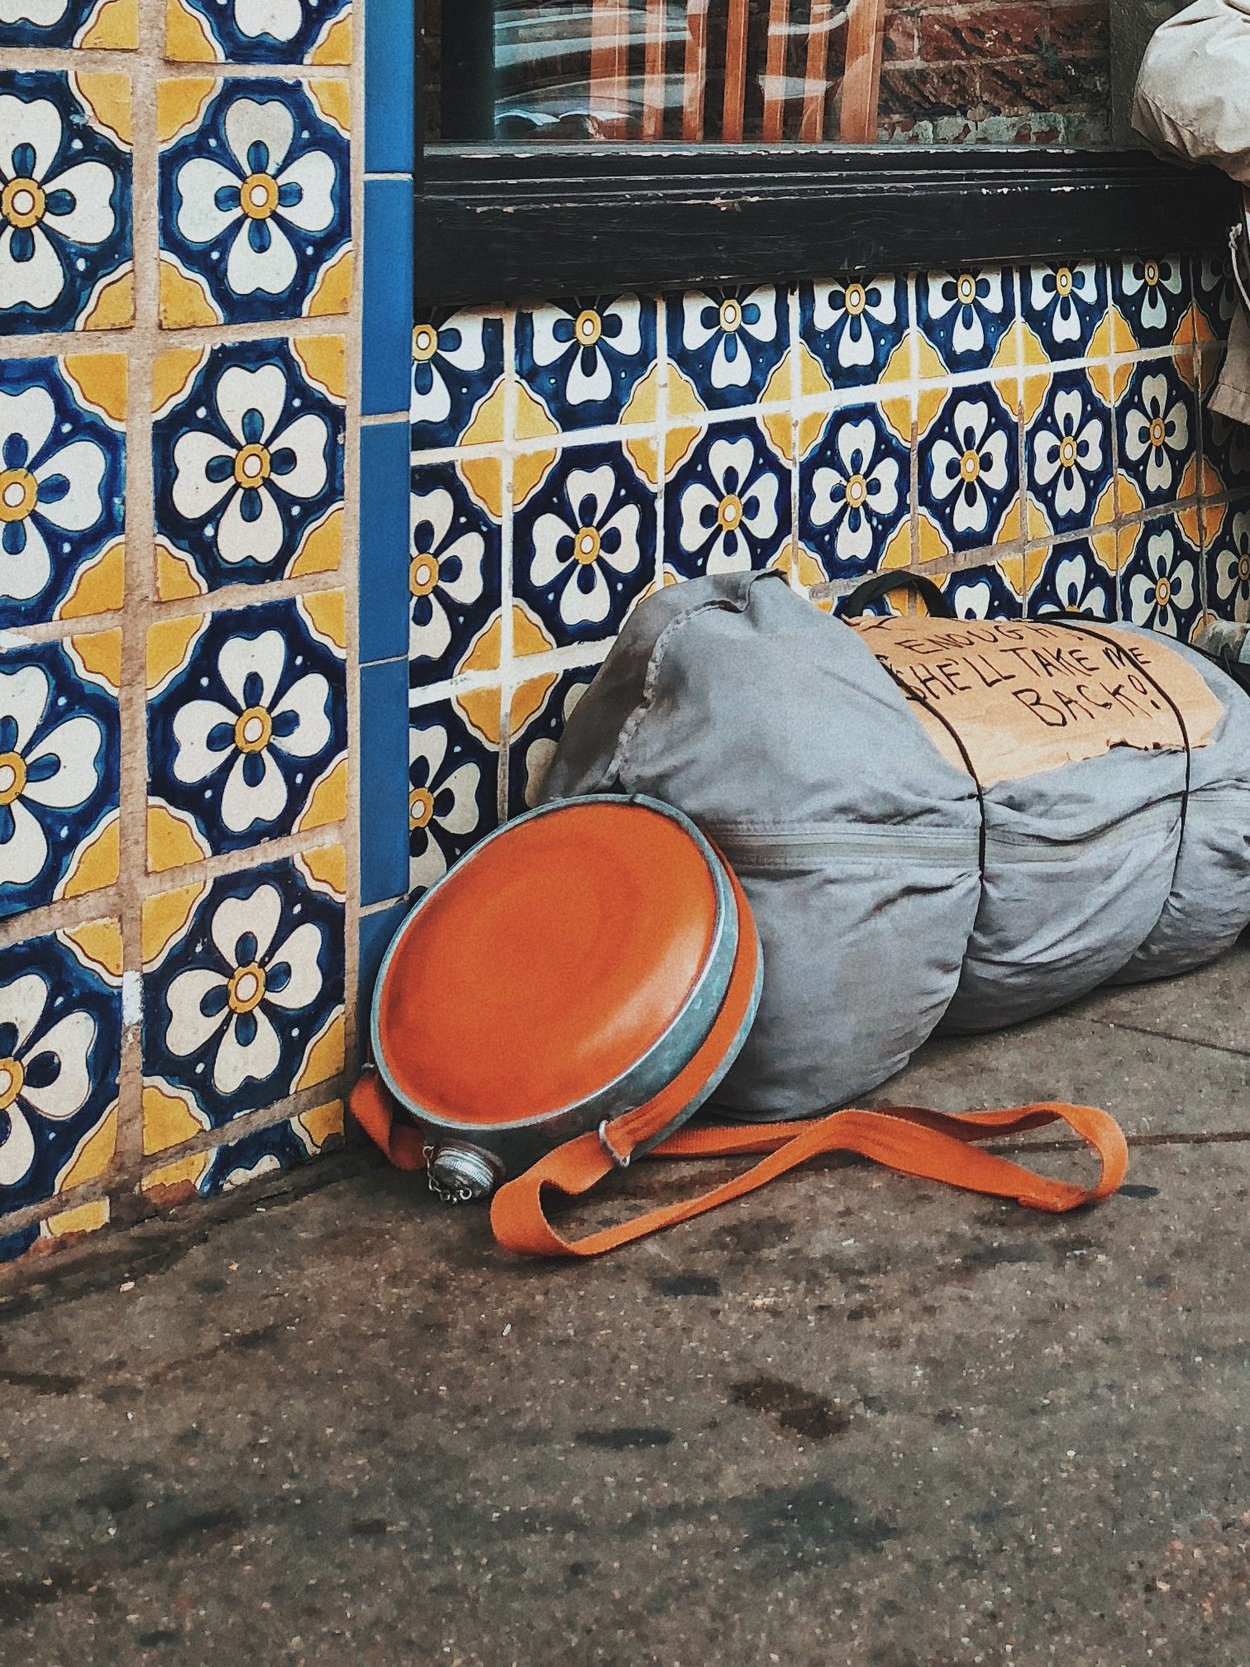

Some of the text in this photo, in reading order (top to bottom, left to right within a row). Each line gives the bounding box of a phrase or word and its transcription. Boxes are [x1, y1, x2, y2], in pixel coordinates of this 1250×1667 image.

[999, 646, 1100, 678] TAKE
[1102, 646, 1152, 670] ME
[1011, 673, 1161, 727] BACK!
